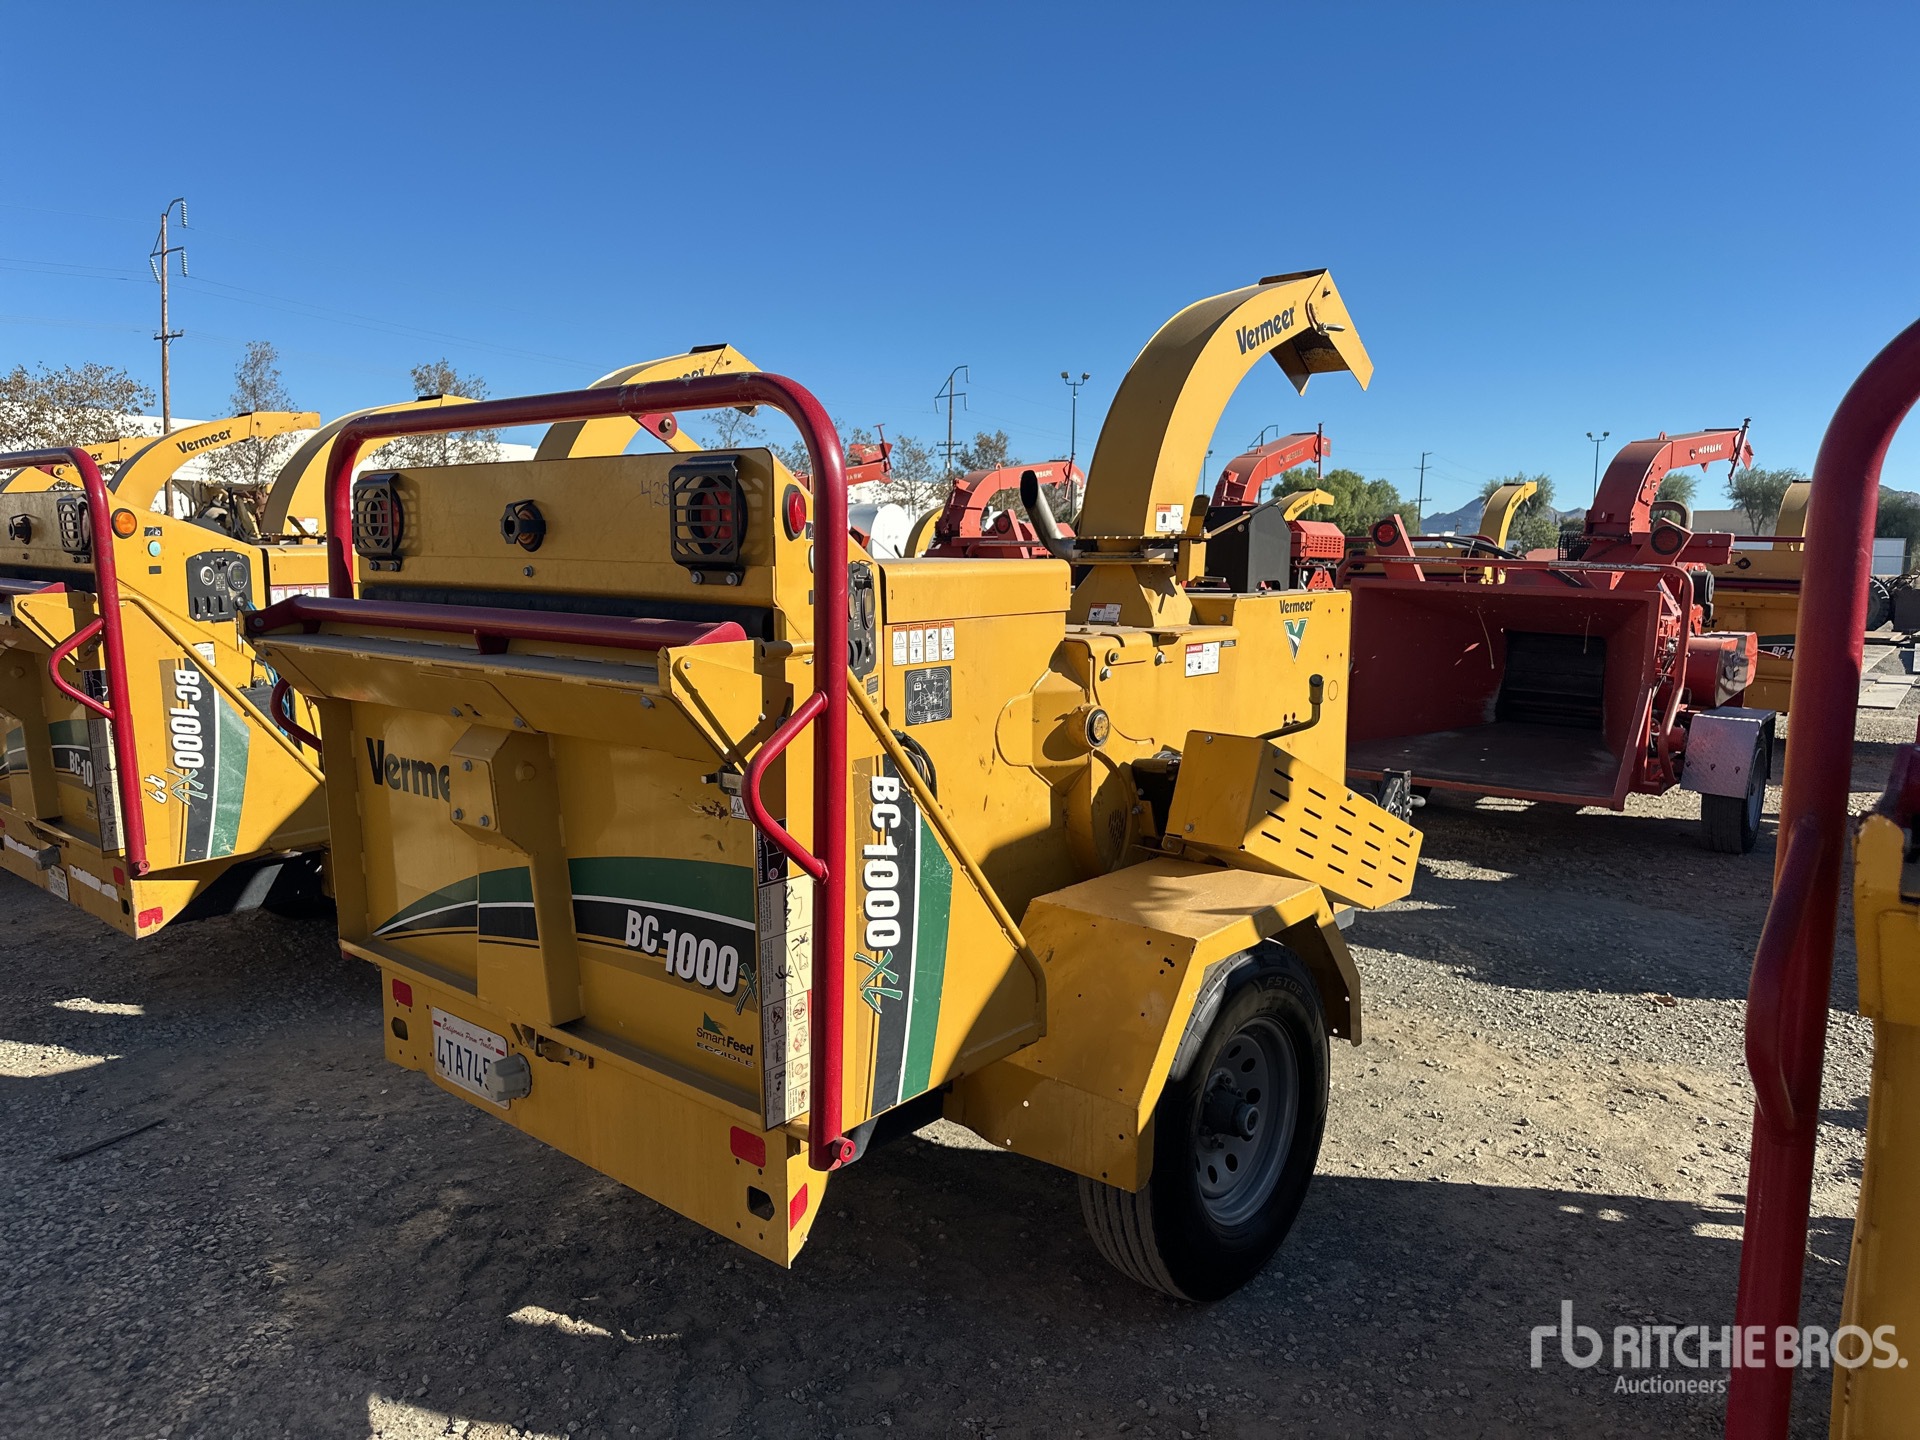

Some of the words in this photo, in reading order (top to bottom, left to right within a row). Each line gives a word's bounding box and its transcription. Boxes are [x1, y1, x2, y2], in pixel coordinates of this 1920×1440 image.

[1235, 306, 1295, 355] Vermeer
[176, 427, 232, 454] Vermeer
[1279, 600, 1313, 614] Vermeer
[442, 1022, 464, 1037] California
[465, 1031, 478, 1044] Perm
[479, 1038, 495, 1052] Trailer
